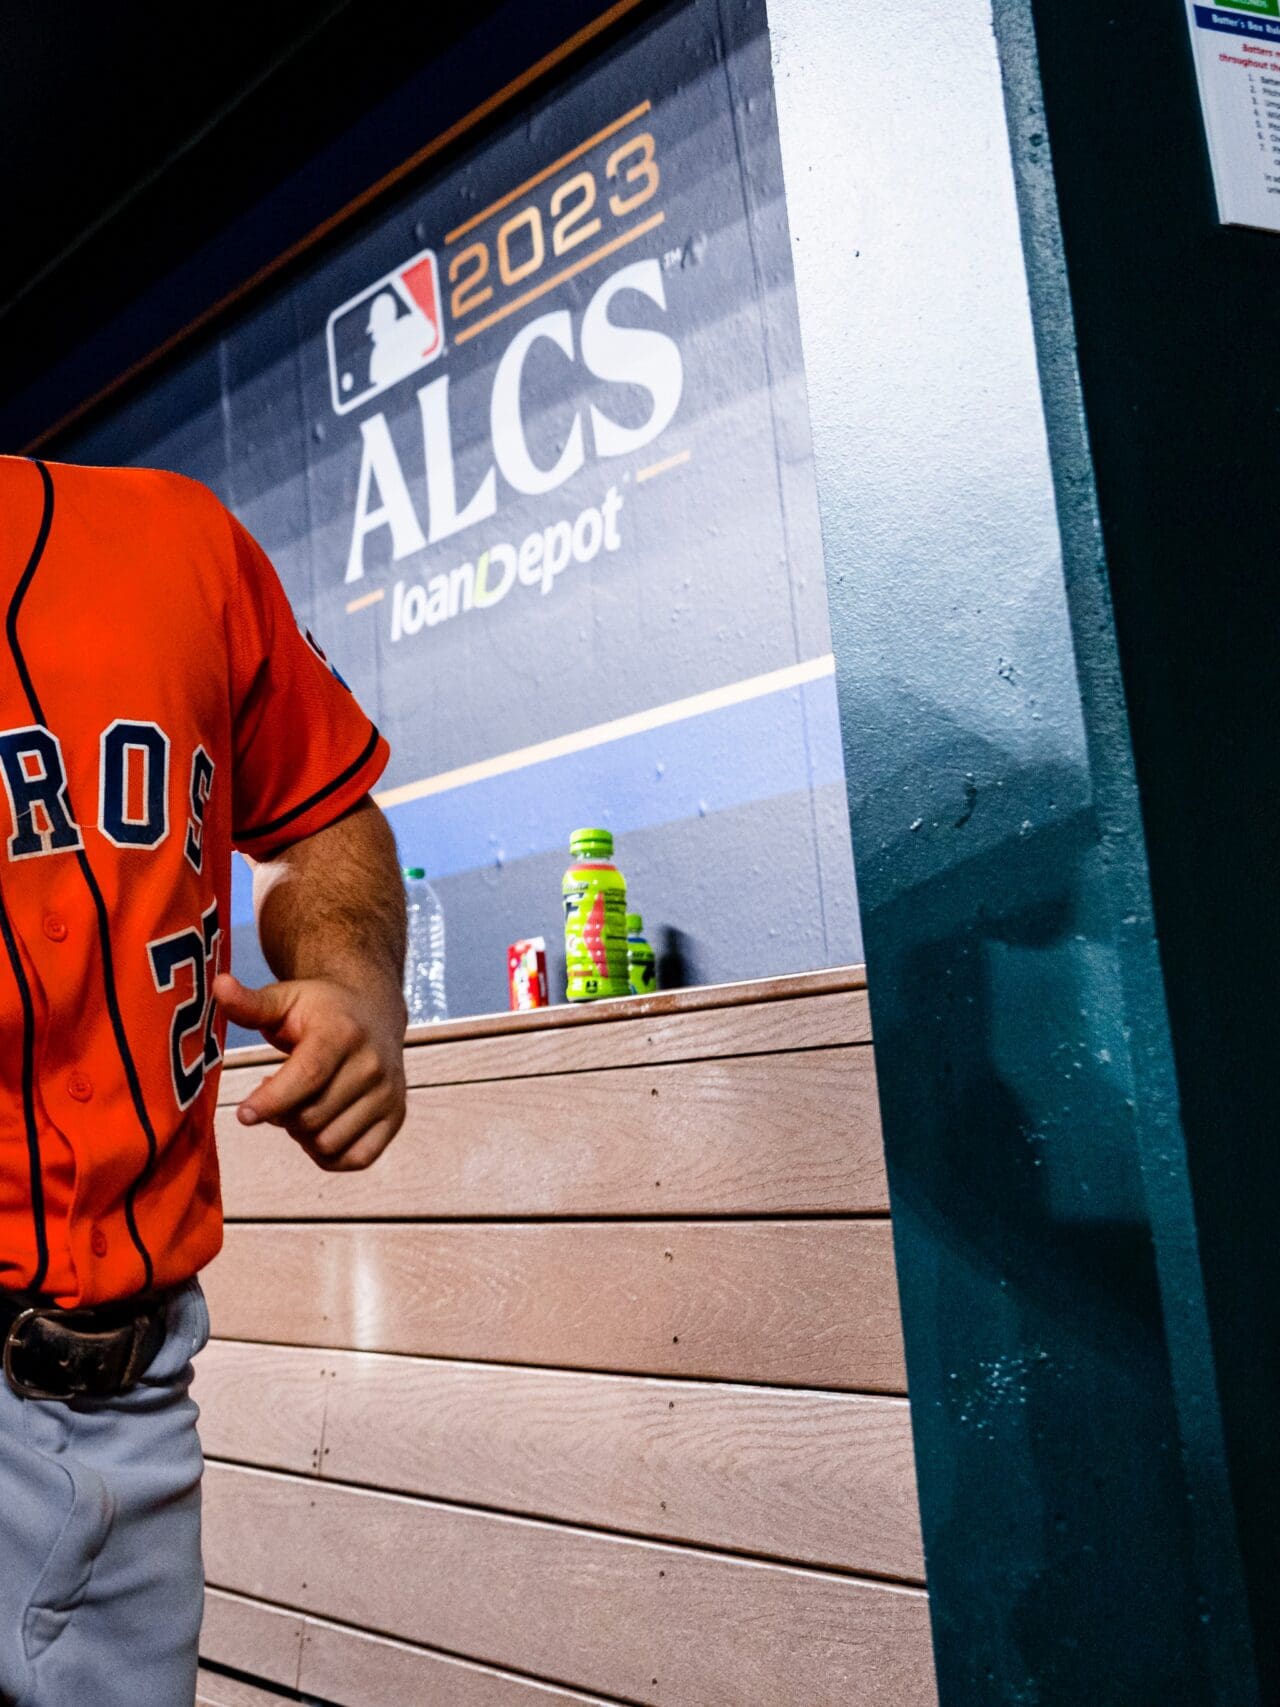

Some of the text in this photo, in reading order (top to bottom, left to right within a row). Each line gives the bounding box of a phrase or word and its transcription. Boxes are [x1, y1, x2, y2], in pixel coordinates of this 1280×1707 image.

[1218, 53, 1268, 69] throughout
[449, 132, 661, 318] 2023
[344, 259, 684, 584] ALCS
[391, 485, 625, 642] loanDepot
